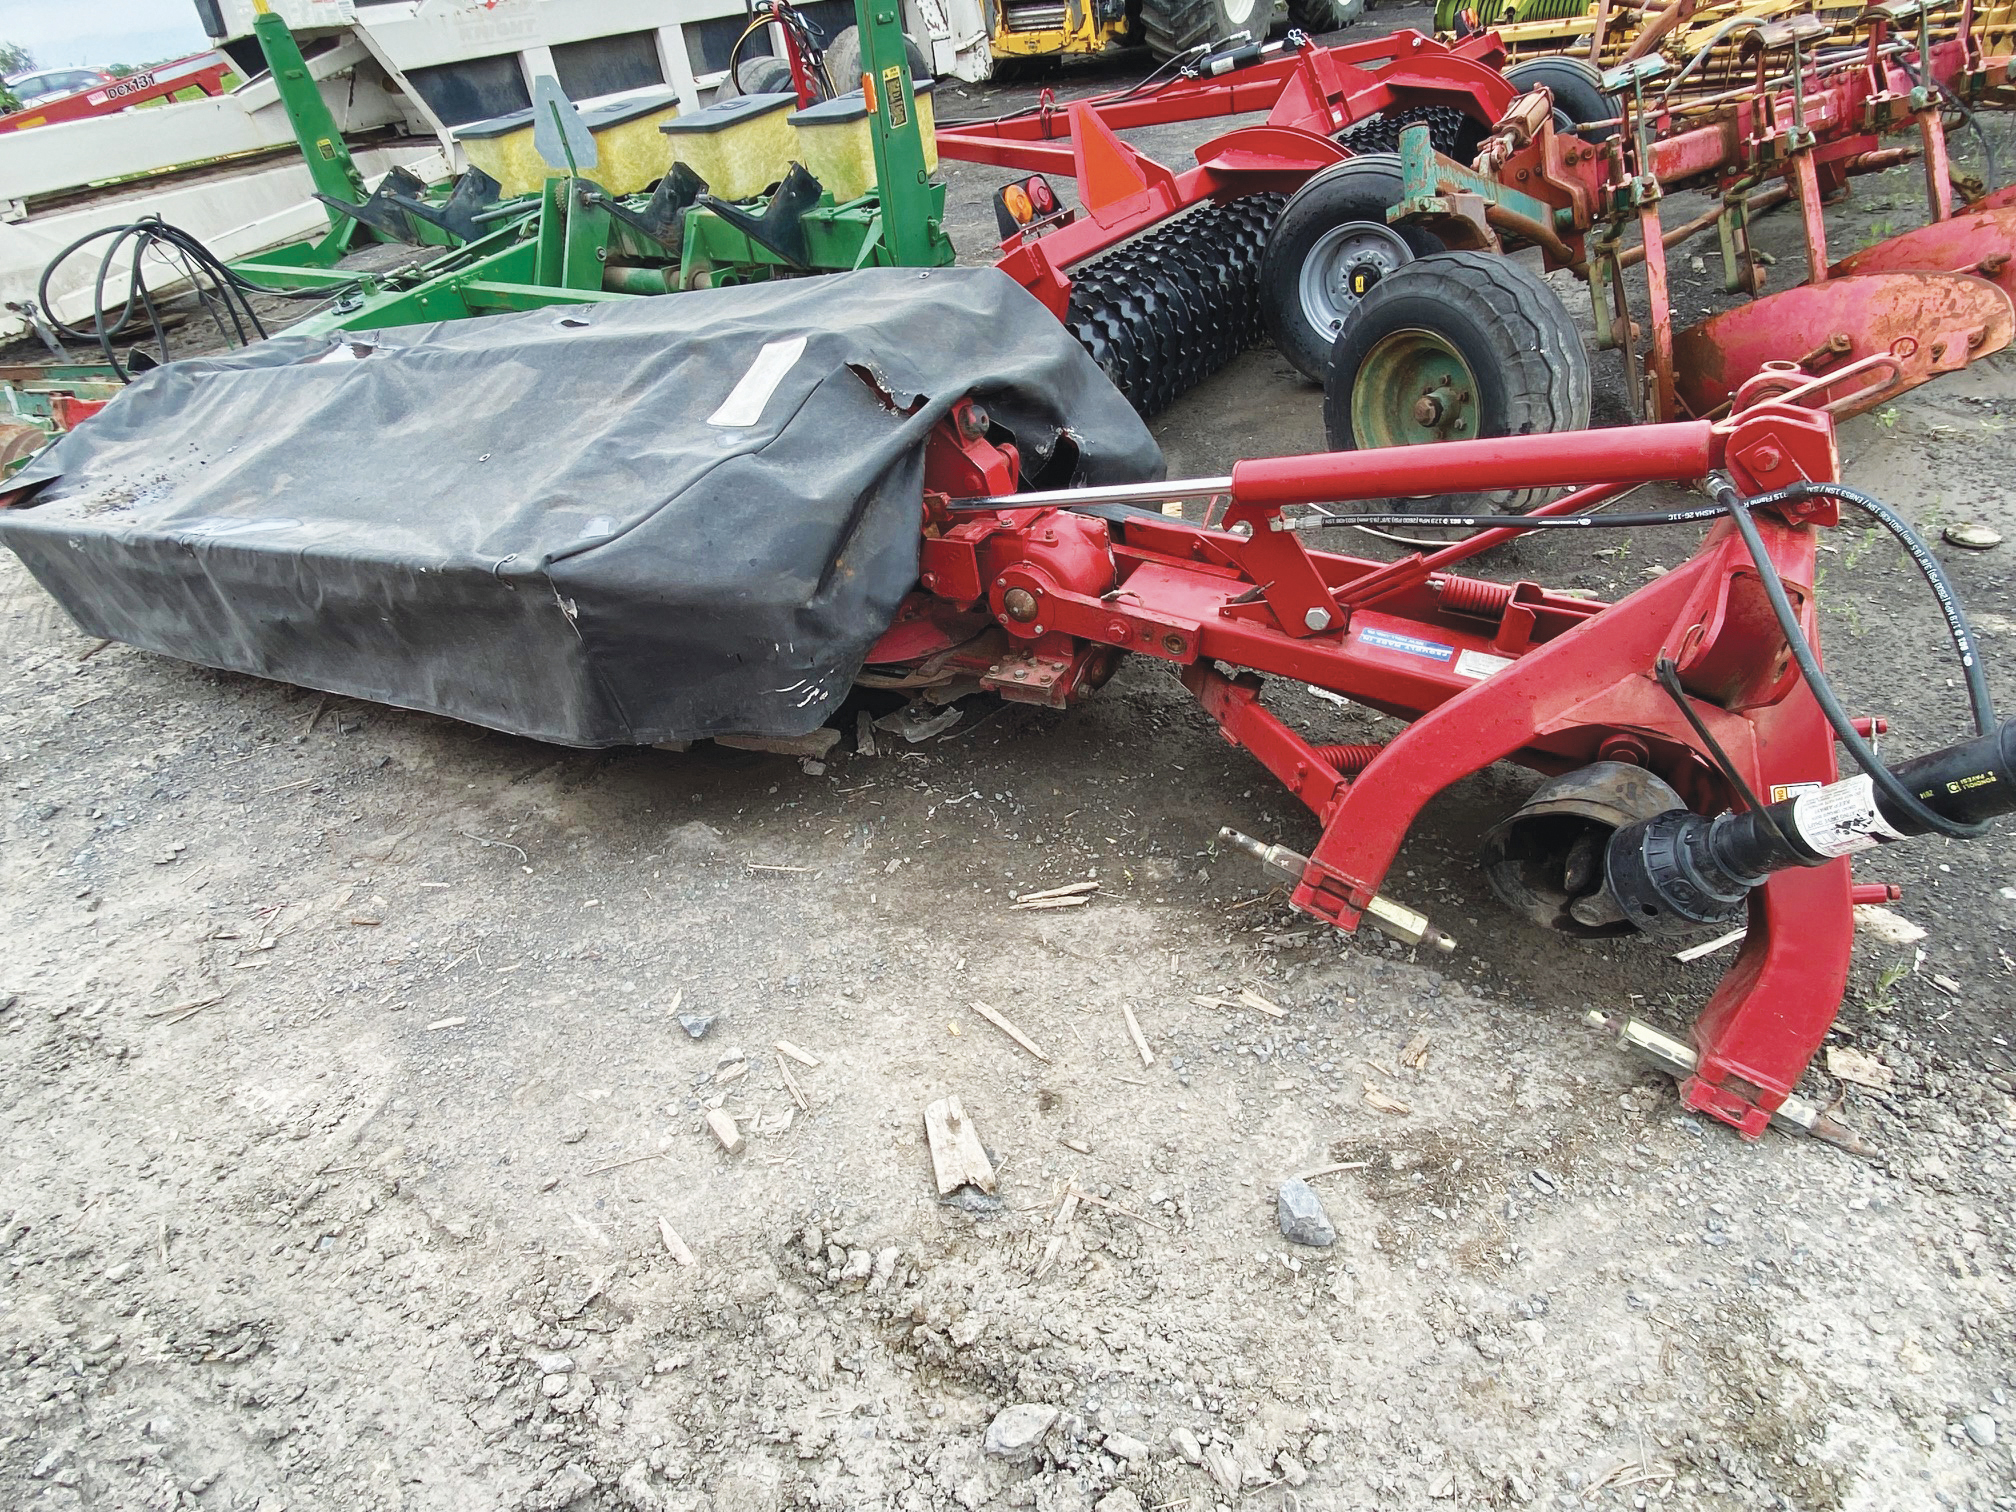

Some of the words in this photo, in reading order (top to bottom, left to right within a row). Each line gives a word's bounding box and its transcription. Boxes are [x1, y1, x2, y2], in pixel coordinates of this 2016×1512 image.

[107, 71, 156, 100] DCX131
[1750, 494, 1773, 506] Flame
[1667, 511, 1694, 521] 2G-11C
[1694, 508, 1715, 519] MSHA
[1960, 773, 1985, 784] PAVESI
[1962, 776, 1997, 790] BONDIOLI
